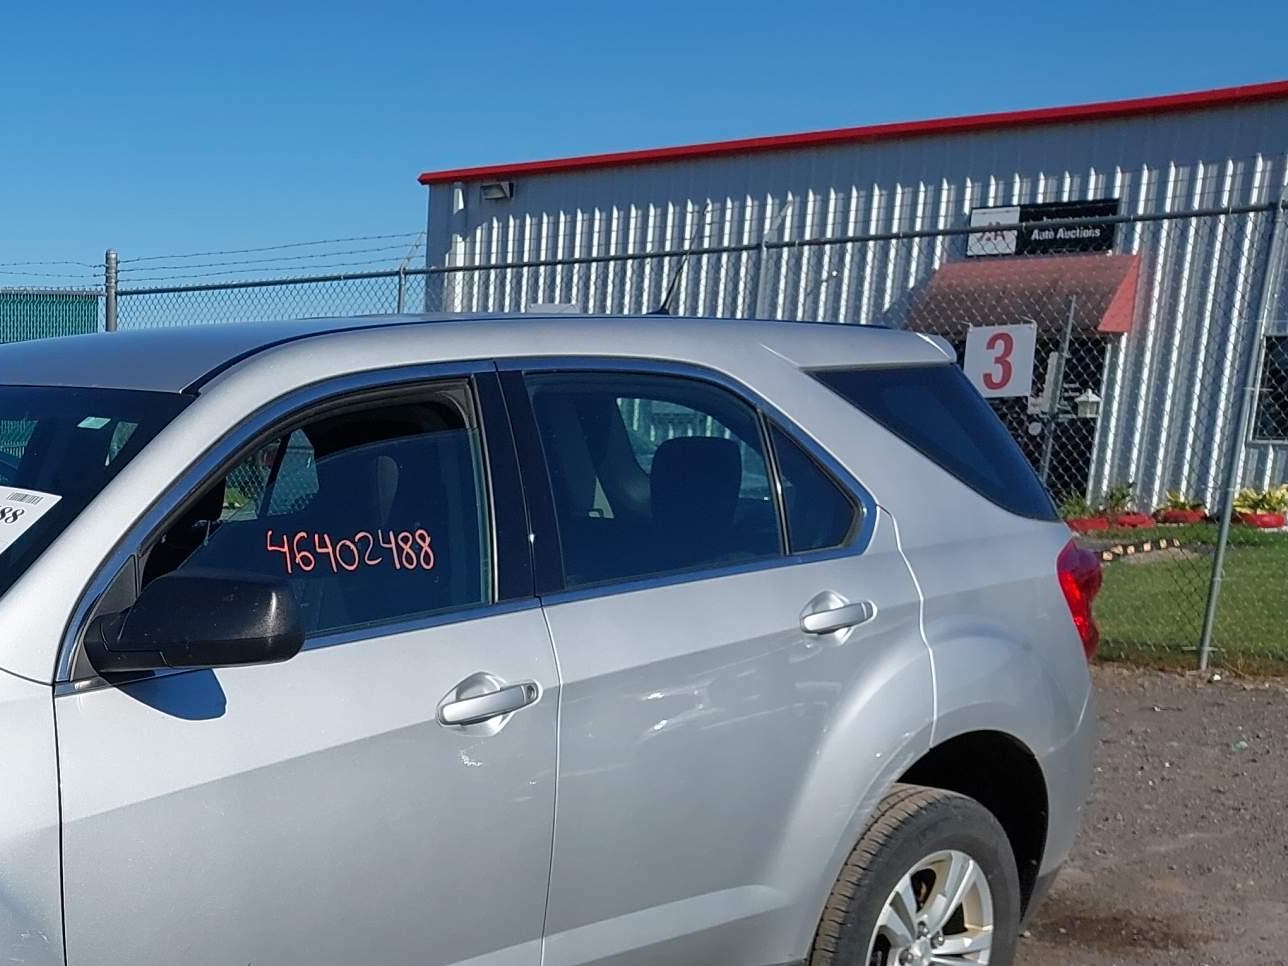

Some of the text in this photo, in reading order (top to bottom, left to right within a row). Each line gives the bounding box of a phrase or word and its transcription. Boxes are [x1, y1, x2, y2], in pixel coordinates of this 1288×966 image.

[1031, 226, 1101, 241] Auto Auctions
[983, 332, 1014, 390] 3
[266, 529, 434, 573] 46402488
